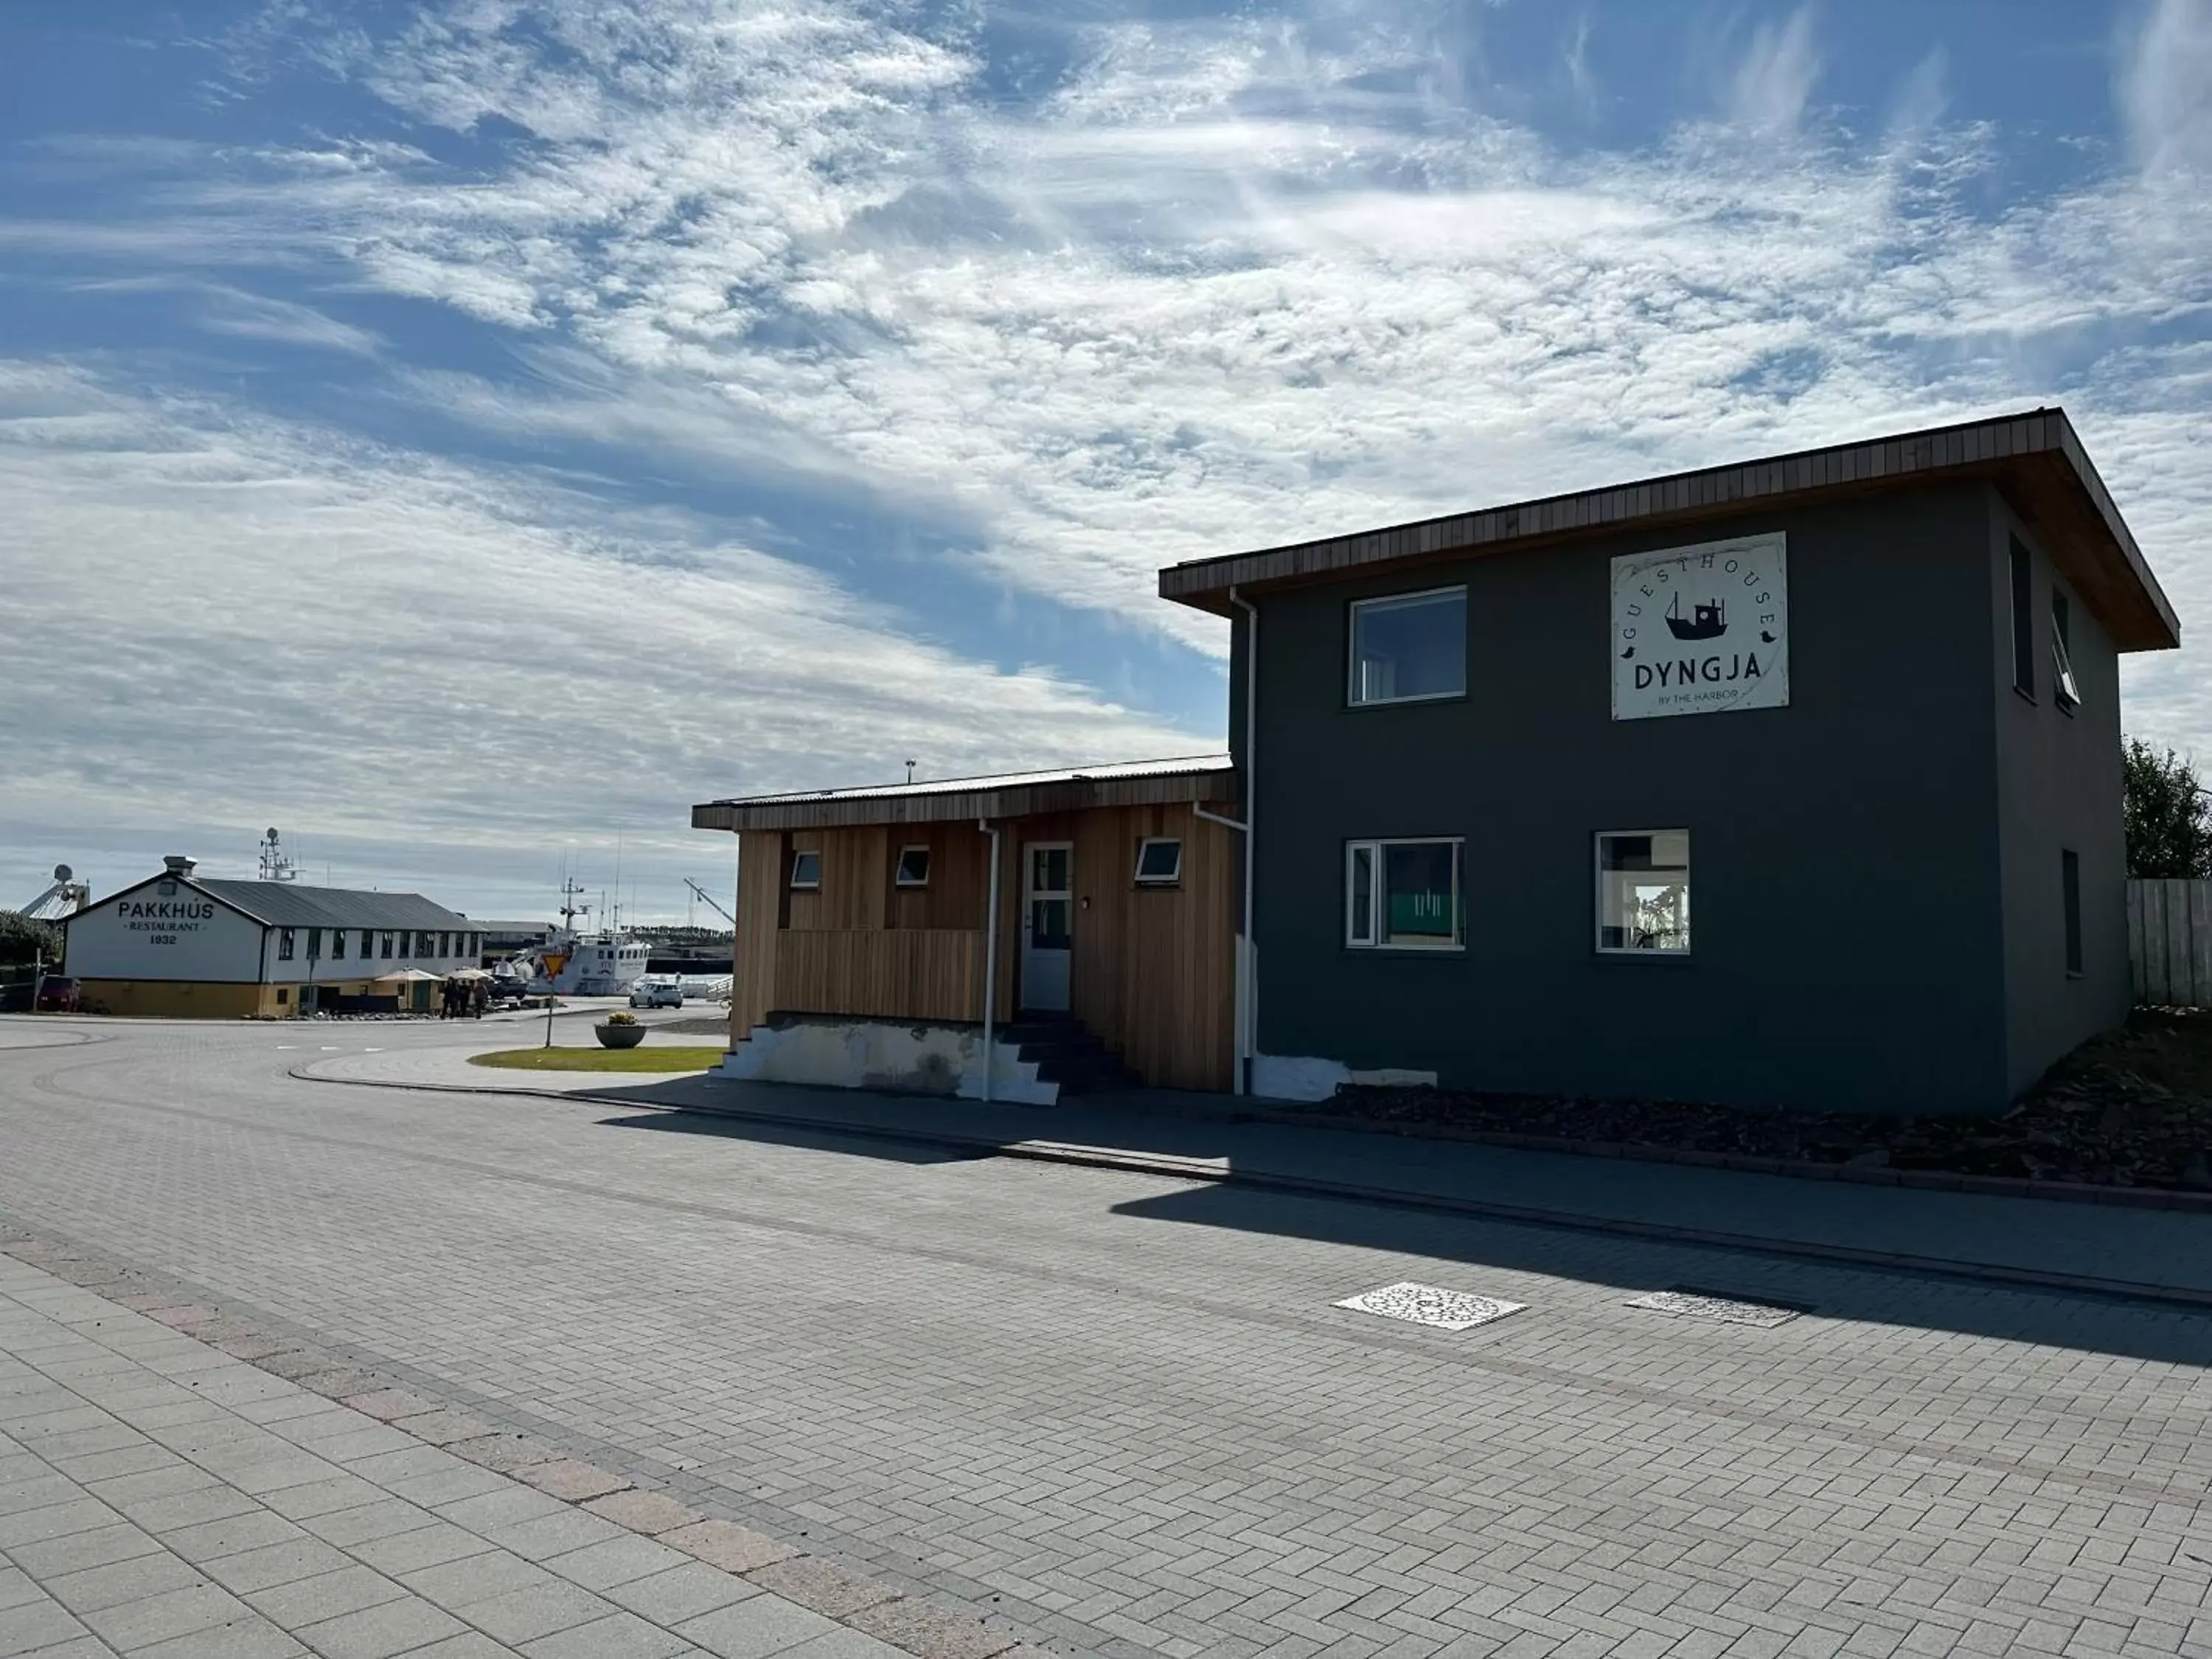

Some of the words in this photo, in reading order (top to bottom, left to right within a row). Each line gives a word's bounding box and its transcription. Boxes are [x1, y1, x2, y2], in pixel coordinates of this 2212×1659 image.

[1635, 652, 1760, 689] DYNGJA
[1674, 694, 1691, 703] THE
[129, 922, 200, 931] RESTAURANT
